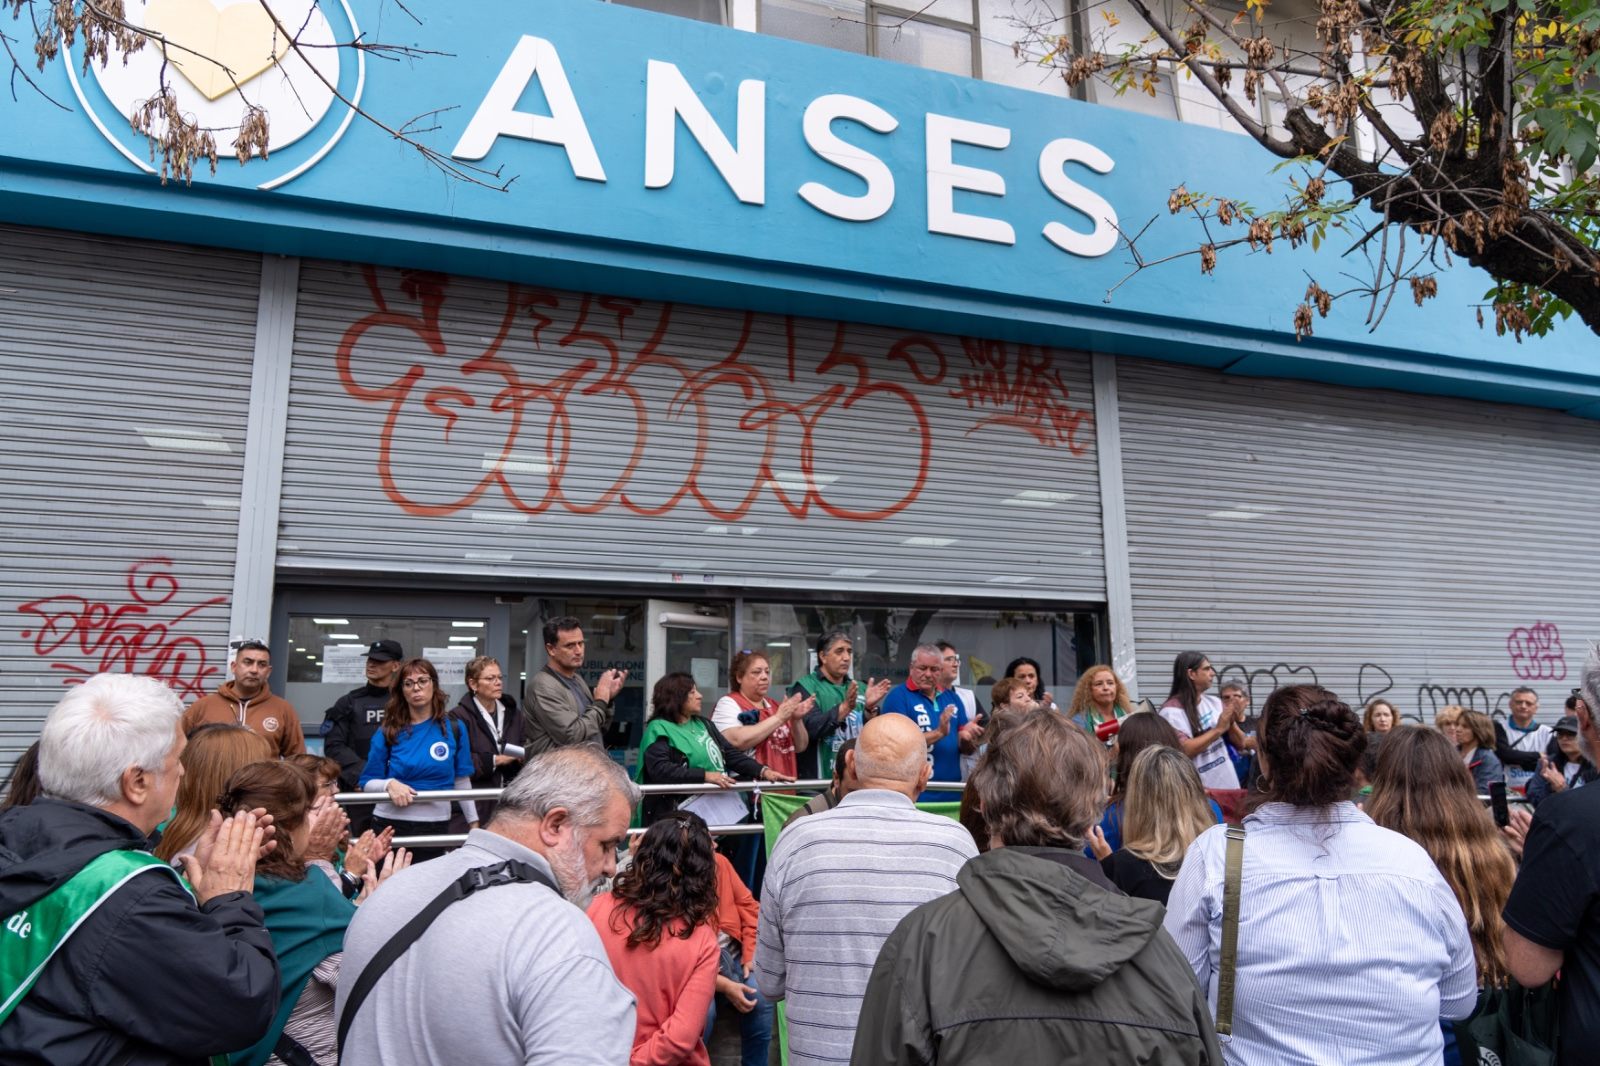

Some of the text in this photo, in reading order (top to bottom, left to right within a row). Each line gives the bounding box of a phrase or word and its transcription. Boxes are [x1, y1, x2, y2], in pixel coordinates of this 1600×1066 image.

[451, 34, 1119, 259] ANSES
[583, 660, 645, 670] UBILACION
[366, 709, 385, 723] PF
[7, 911, 32, 939] de
